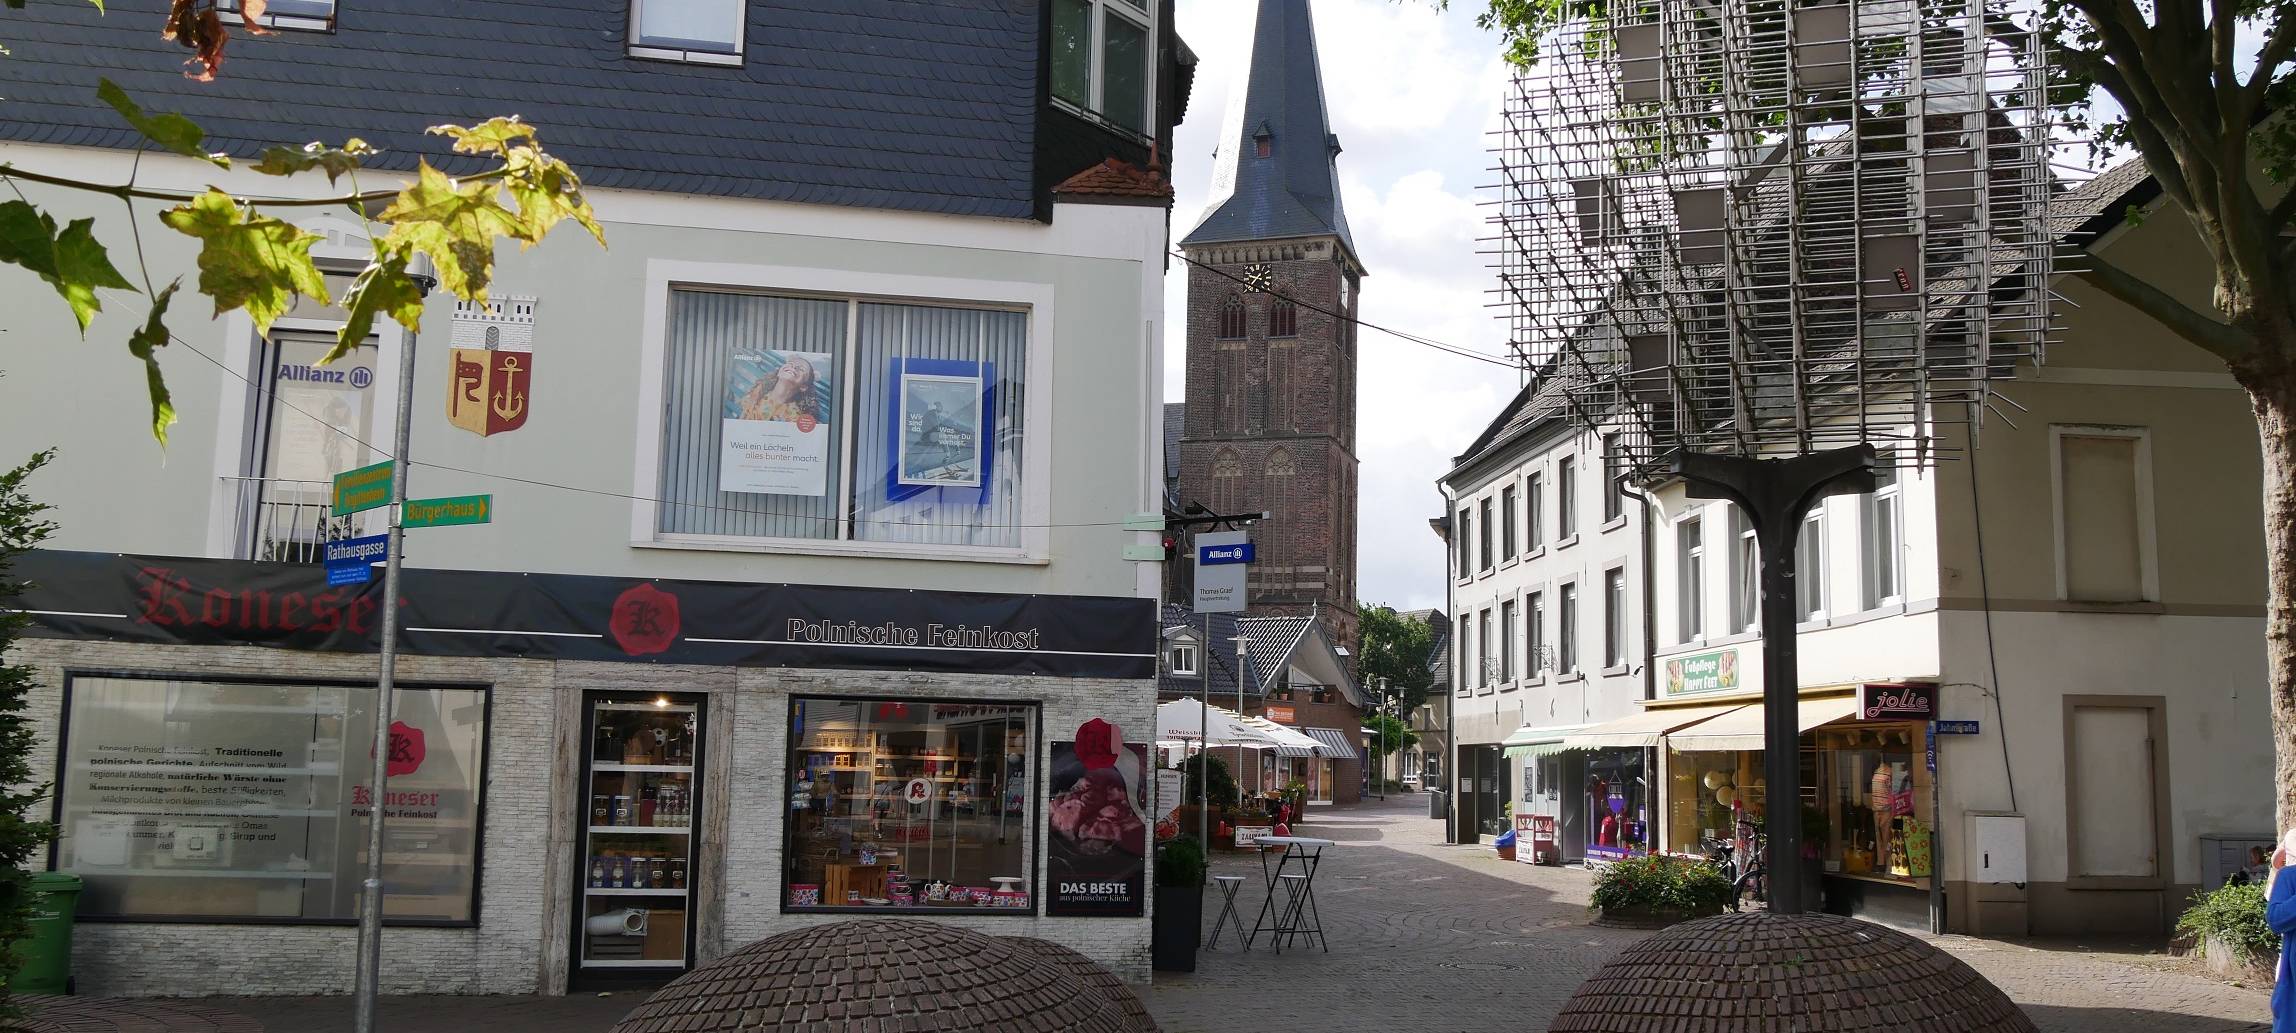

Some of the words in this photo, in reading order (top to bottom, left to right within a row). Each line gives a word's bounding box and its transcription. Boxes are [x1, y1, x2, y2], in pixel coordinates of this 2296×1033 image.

[278, 364, 345, 383] Allianz
[730, 441, 749, 450] Weil
[749, 442, 762, 450] ein
[763, 441, 794, 452] Lächeln
[745, 452, 763, 460] alles
[765, 453, 791, 462] bunter
[408, 501, 475, 524] Bürgerhaus
[327, 541, 385, 561] Rathausgasse
[1208, 550, 1233, 559] Allianz
[787, 618, 918, 646] Polnische
[927, 623, 1039, 650] Feinkost
[1867, 688, 1930, 718] jolie
[215, 747, 283, 758] Traditionelle
[89, 770, 127, 780] regionale
[167, 772, 220, 781] natürliche
[223, 773, 260, 782] Würste
[262, 775, 287, 783] ohne
[201, 785, 228, 794] beste
[165, 797, 181, 805] von
[351, 785, 440, 807] Kneser
[351, 808, 396, 817] Polnhe
[398, 809, 438, 819] Feinkost
[257, 832, 277, 841] und
[1060, 882, 1087, 894] DAS
[1089, 882, 1127, 894] BESTE
[1072, 893, 1108, 902] polnischer
